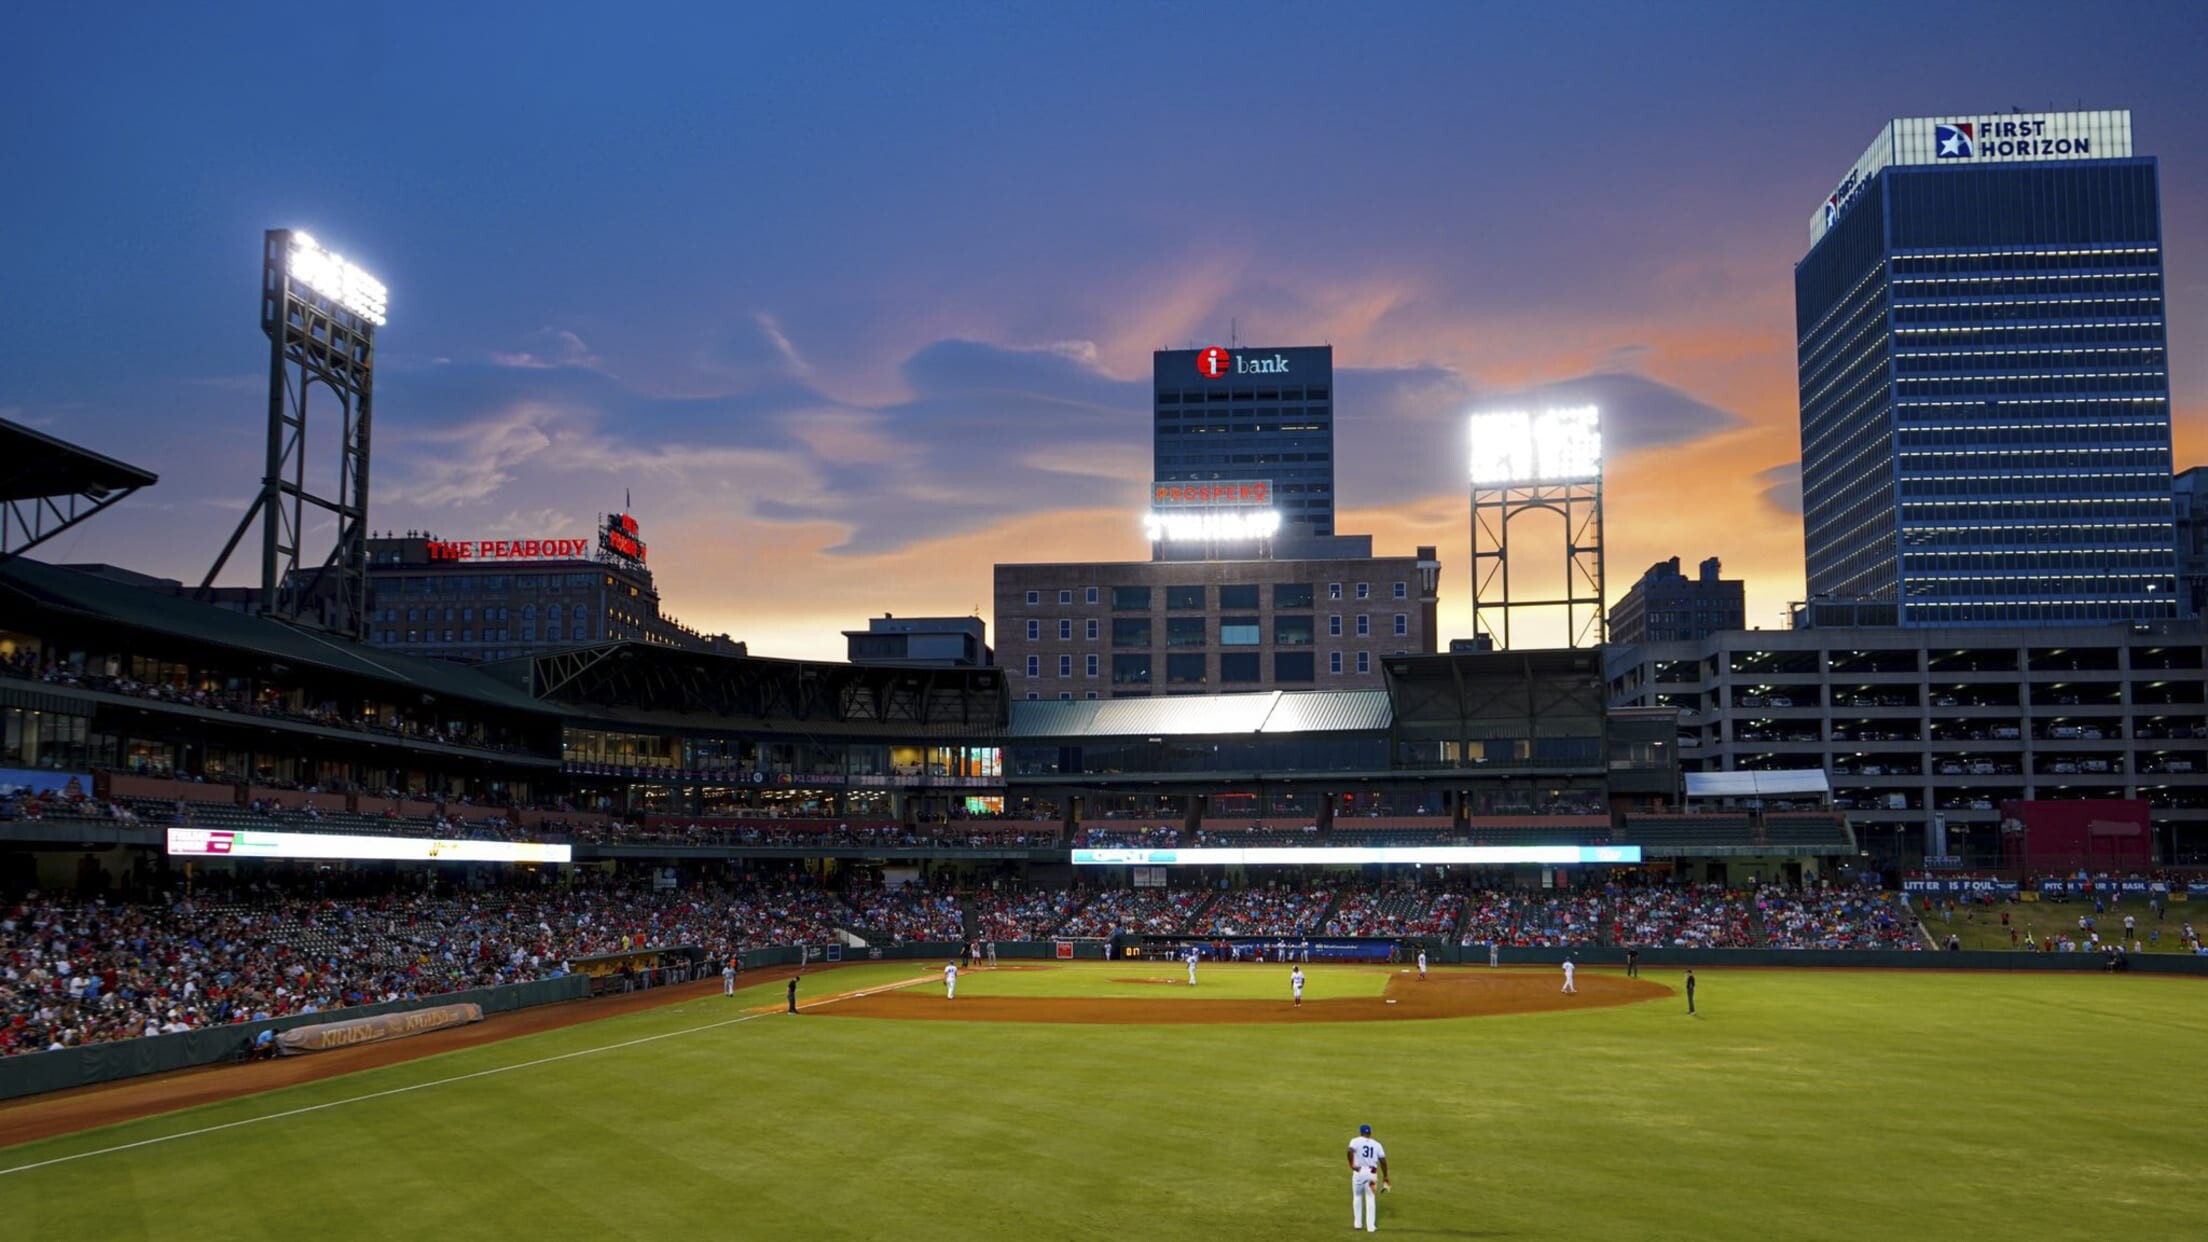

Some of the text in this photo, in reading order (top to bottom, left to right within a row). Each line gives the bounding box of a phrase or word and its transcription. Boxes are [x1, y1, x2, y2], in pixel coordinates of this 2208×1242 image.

[1980, 120, 2045, 138] FIRST
[1981, 138, 2089, 157] HORIZON
[1236, 354, 1289, 374] bank
[427, 538, 586, 560] THE PEABODY
[1904, 881, 1940, 890] LITTER
[1949, 881, 1959, 890] IS
[1963, 881, 1995, 890] FOUL
[2044, 882, 2075, 890] PITCH
[2078, 882, 2107, 890] YUR
[1362, 1146, 1374, 1159] 31
